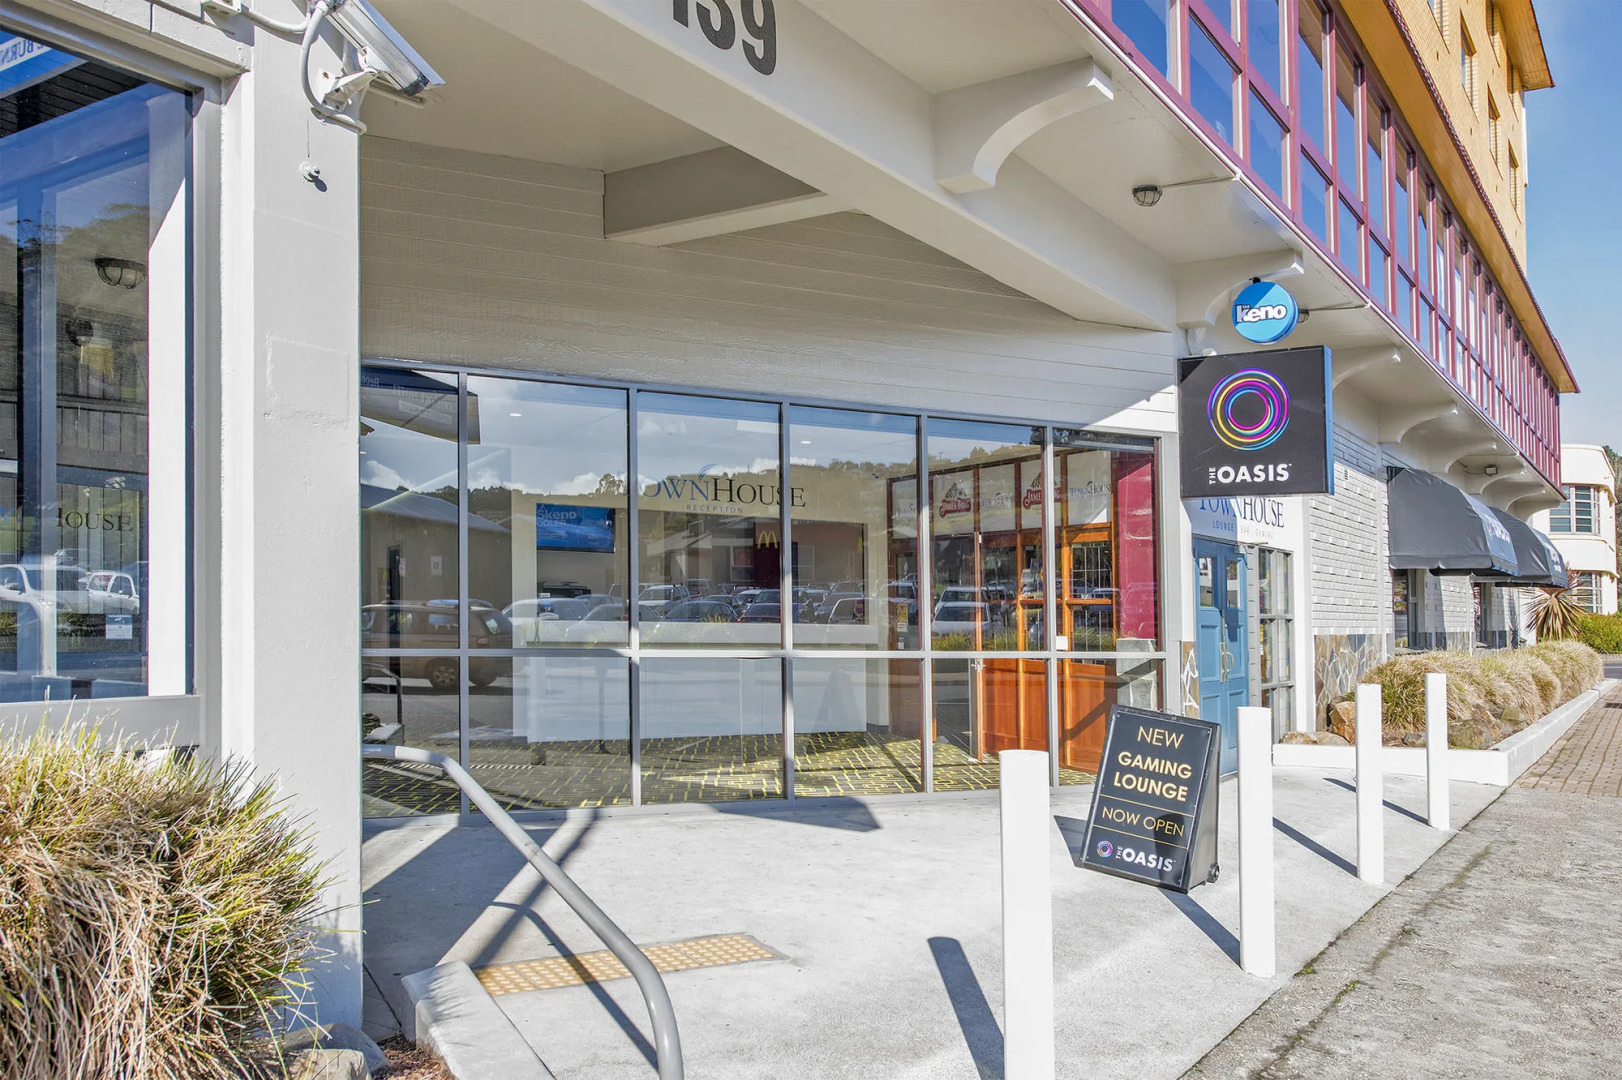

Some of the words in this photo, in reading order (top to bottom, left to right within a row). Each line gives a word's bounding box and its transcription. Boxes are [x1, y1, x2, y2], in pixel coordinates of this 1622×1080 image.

[673, 0, 777, 76] 39
[1208, 467, 1217, 485] THE
[1217, 463, 1290, 484] OASIS
[686, 504, 744, 514] RECEPTION
[1212, 519, 1234, 532] LOUNGE
[1137, 725, 1184, 750] NEW
[1118, 751, 1192, 779] GAMING
[1113, 772, 1188, 802] LOUNGE
[1101, 806, 1140, 827] NOW
[1143, 816, 1185, 837] OPEN
[1122, 848, 1174, 872] OASIS
